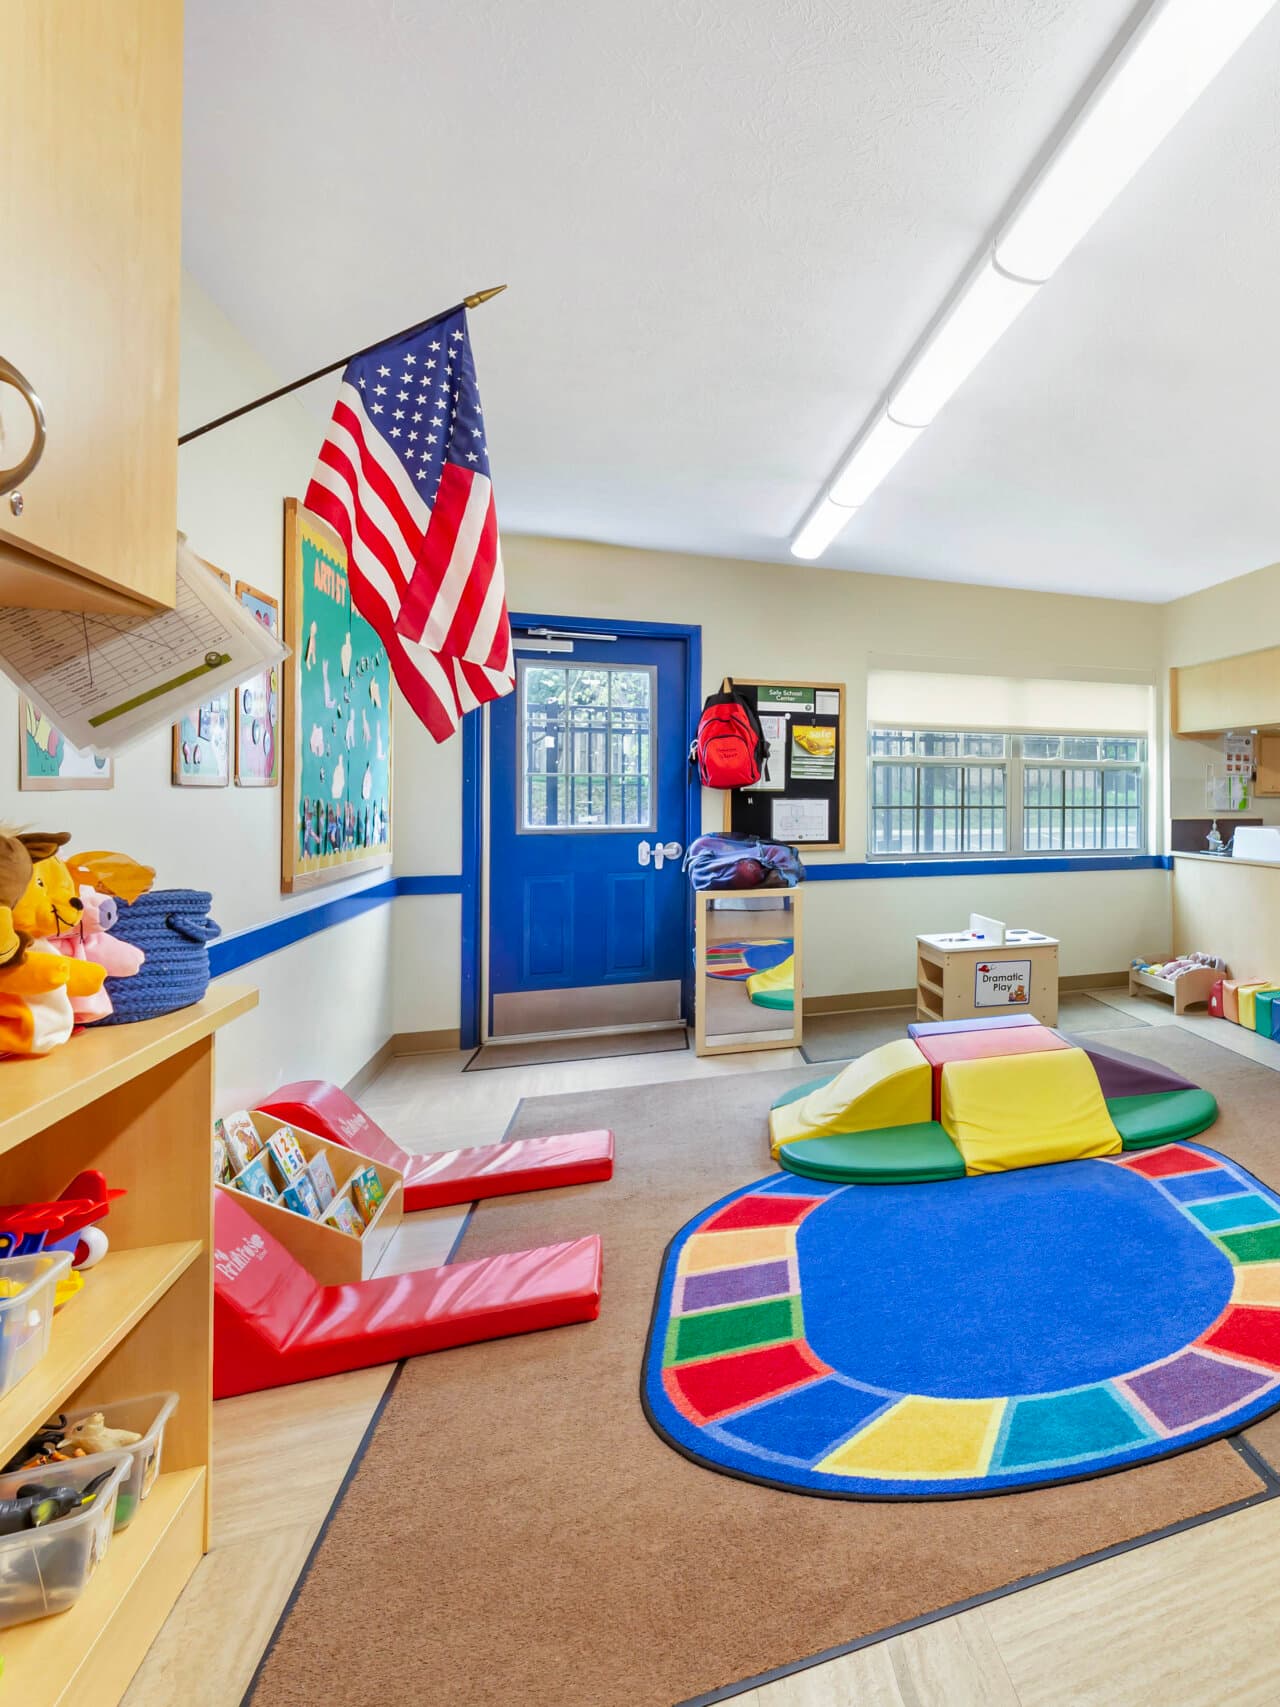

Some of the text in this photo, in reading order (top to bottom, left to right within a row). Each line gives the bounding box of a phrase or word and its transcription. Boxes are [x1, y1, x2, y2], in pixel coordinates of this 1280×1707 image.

[314, 558, 346, 607] ARTIST
[982, 972, 1024, 983] Dramatic
[993, 983, 1013, 992] Play
